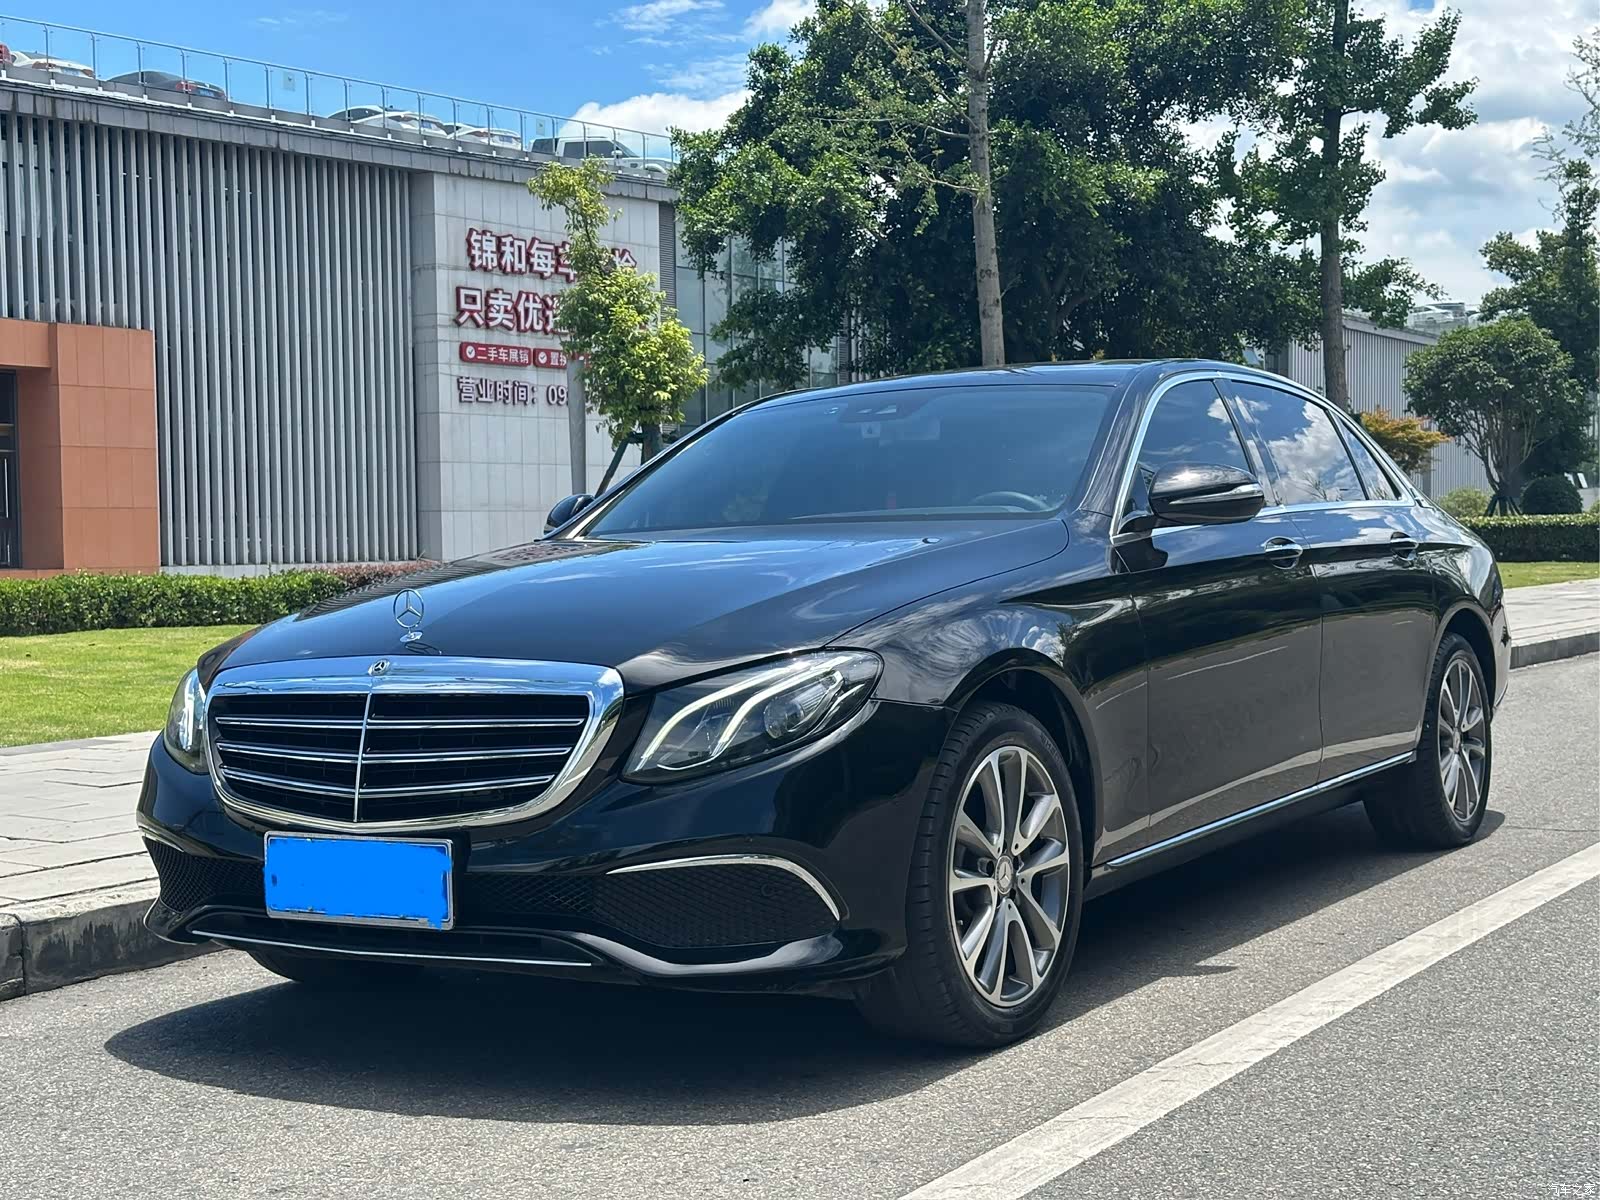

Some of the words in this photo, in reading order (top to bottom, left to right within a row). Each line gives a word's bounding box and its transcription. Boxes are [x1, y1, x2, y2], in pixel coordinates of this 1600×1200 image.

[476, 346, 529, 364] 二手车展销
[547, 385, 569, 406] 09
